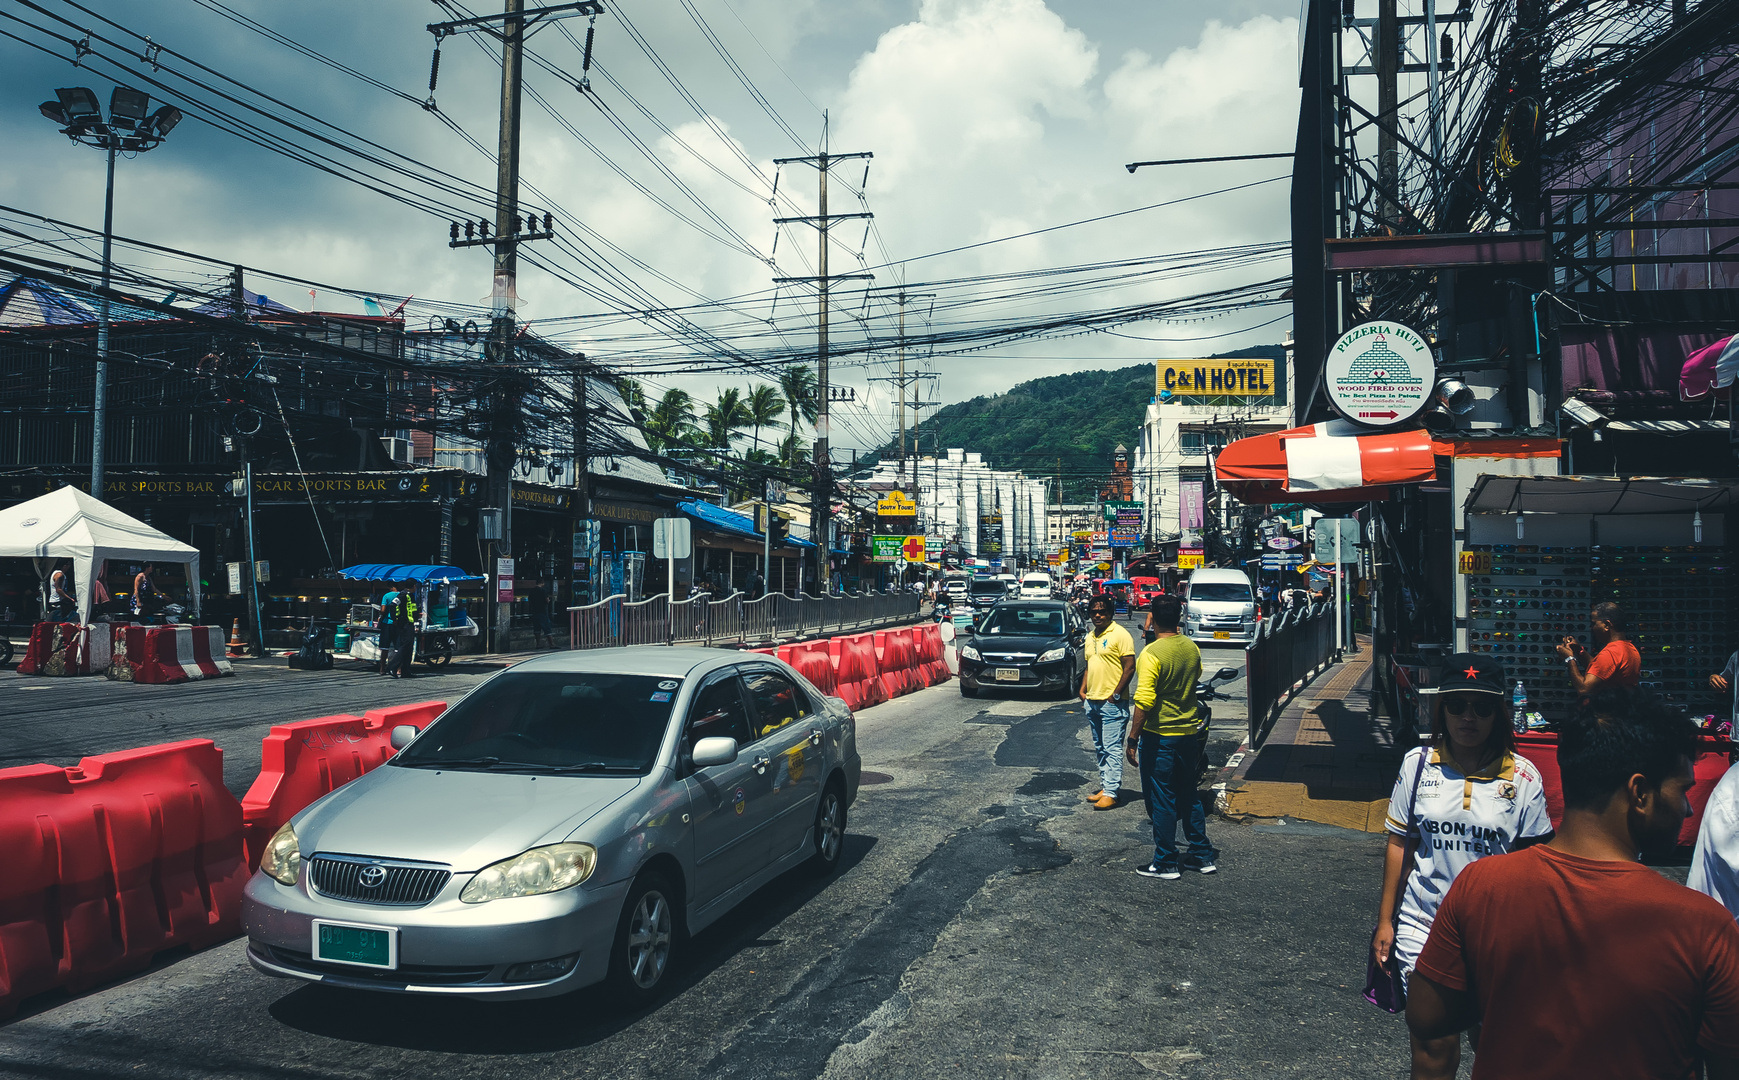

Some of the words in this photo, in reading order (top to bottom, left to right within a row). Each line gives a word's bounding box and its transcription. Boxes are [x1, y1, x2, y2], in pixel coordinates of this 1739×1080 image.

[1337, 326, 1391, 353] PIZZERIA
[1164, 367, 1206, 390] C&N
[1211, 367, 1269, 390] HOTEL
[131, 481, 181, 492] SPORTS
[186, 481, 215, 492] BAR
[297, 479, 351, 491] SPORTS
[356, 479, 387, 490] BAR
[517, 490, 541, 503] SPORTS
[542, 493, 555, 504] BAR
[594, 503, 616, 518] OSCAR
[617, 507, 630, 520] LIVE
[631, 508, 652, 522] SPORTS
